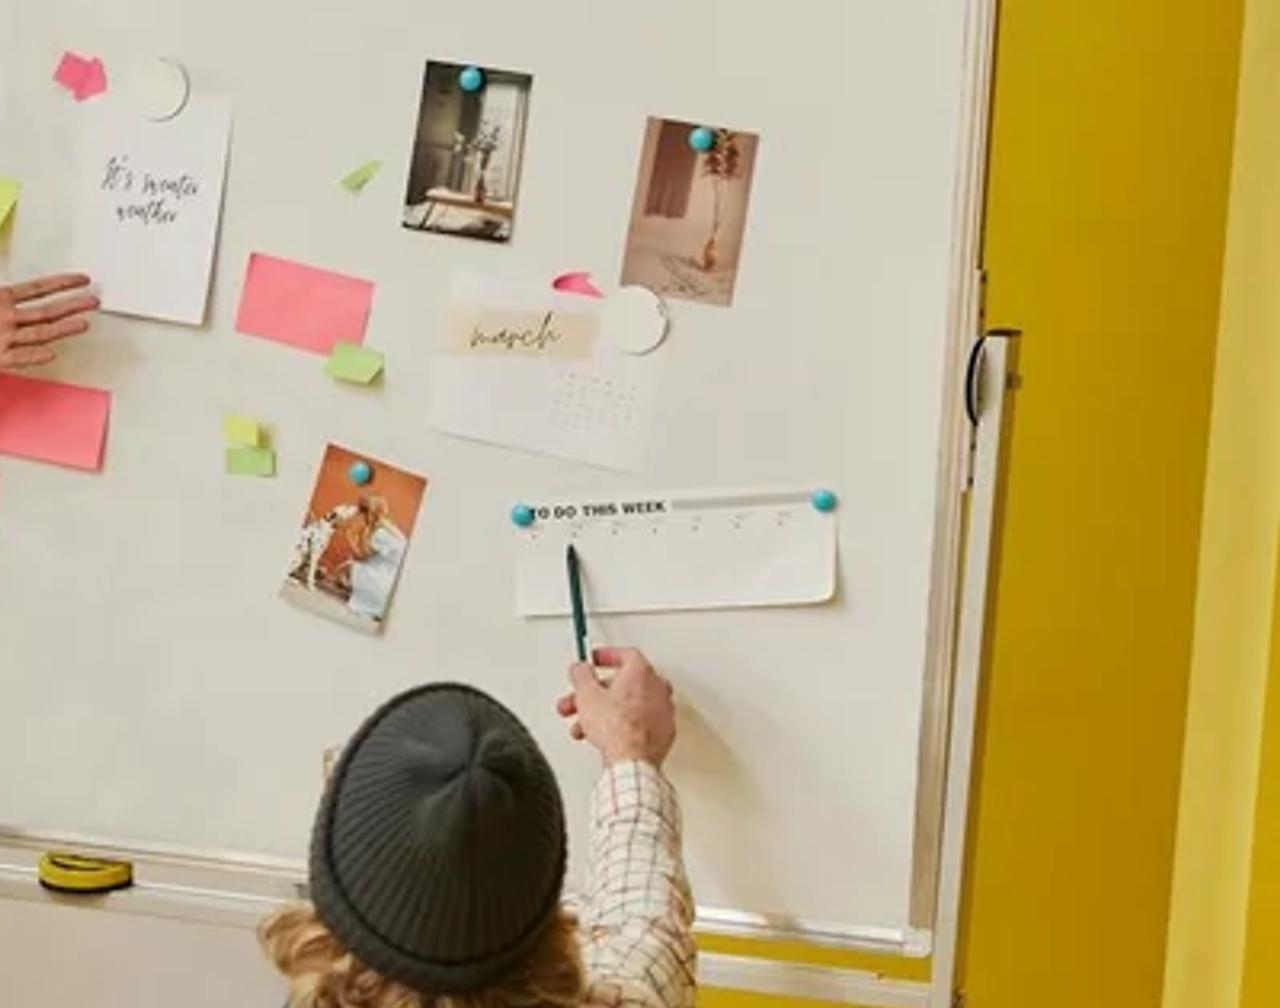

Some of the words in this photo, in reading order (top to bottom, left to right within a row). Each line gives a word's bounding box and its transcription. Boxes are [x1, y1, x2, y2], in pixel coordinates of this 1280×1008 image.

[100, 155, 132, 190] It's
[554, 505, 577, 519] DO
[582, 503, 618, 517] THIS
[621, 502, 666, 514] WEEK
